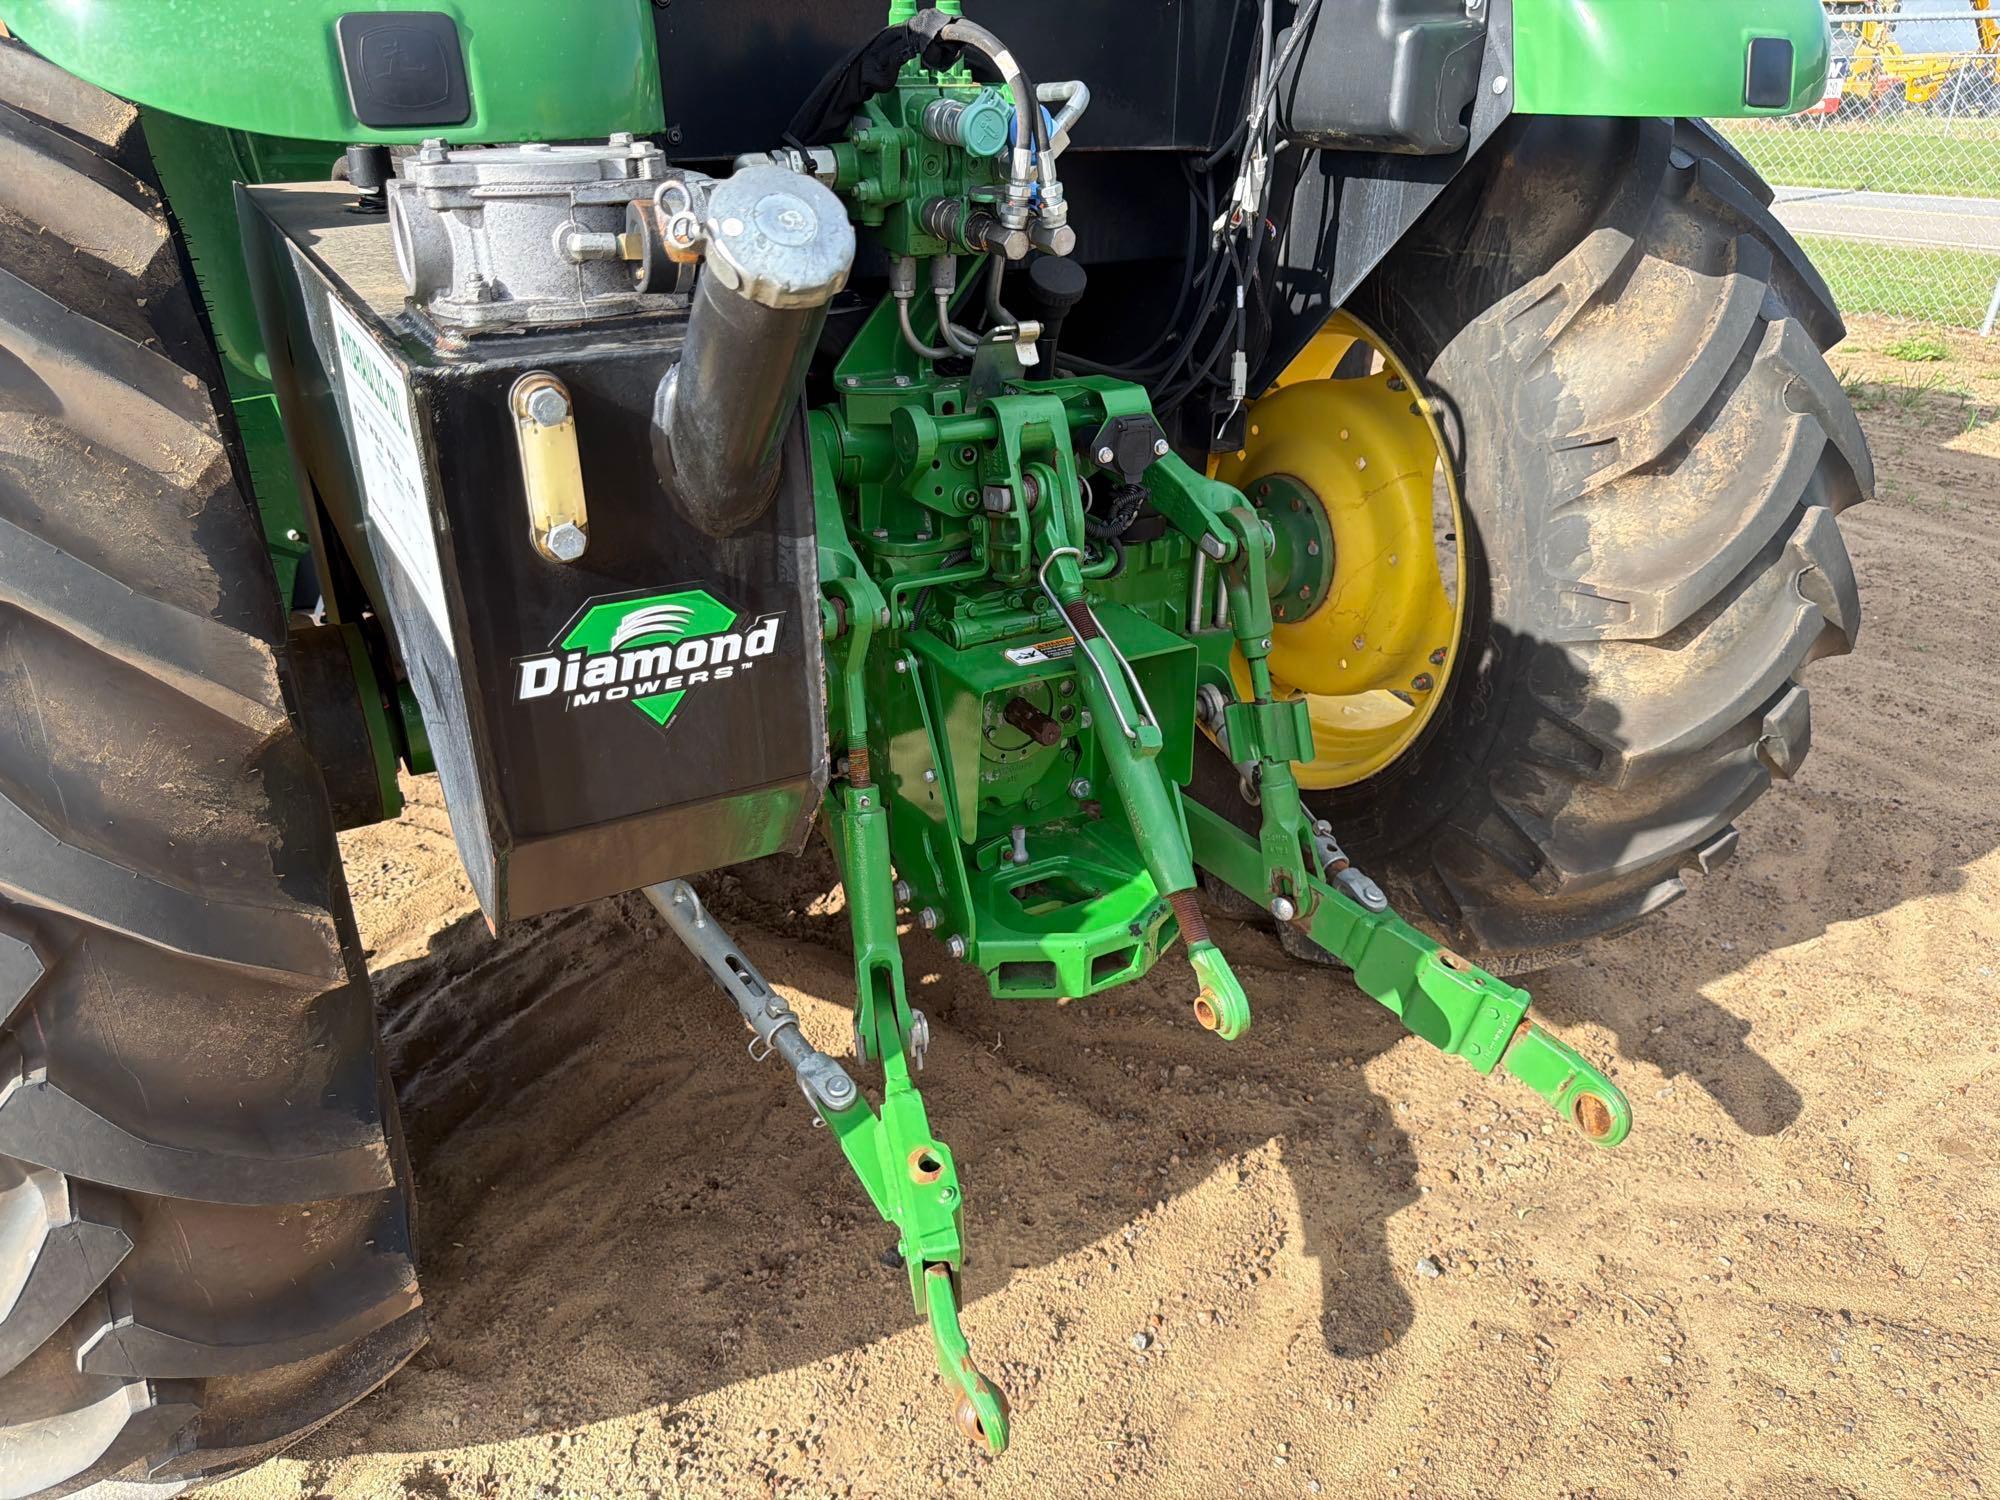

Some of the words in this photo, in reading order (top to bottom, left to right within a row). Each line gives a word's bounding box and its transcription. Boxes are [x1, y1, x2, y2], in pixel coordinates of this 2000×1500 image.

[338, 321, 389, 411] HYDRAULIC
[385, 379, 407, 437] OIL
[519, 618, 779, 700] Diamond
[573, 666, 734, 707] MOWERS
